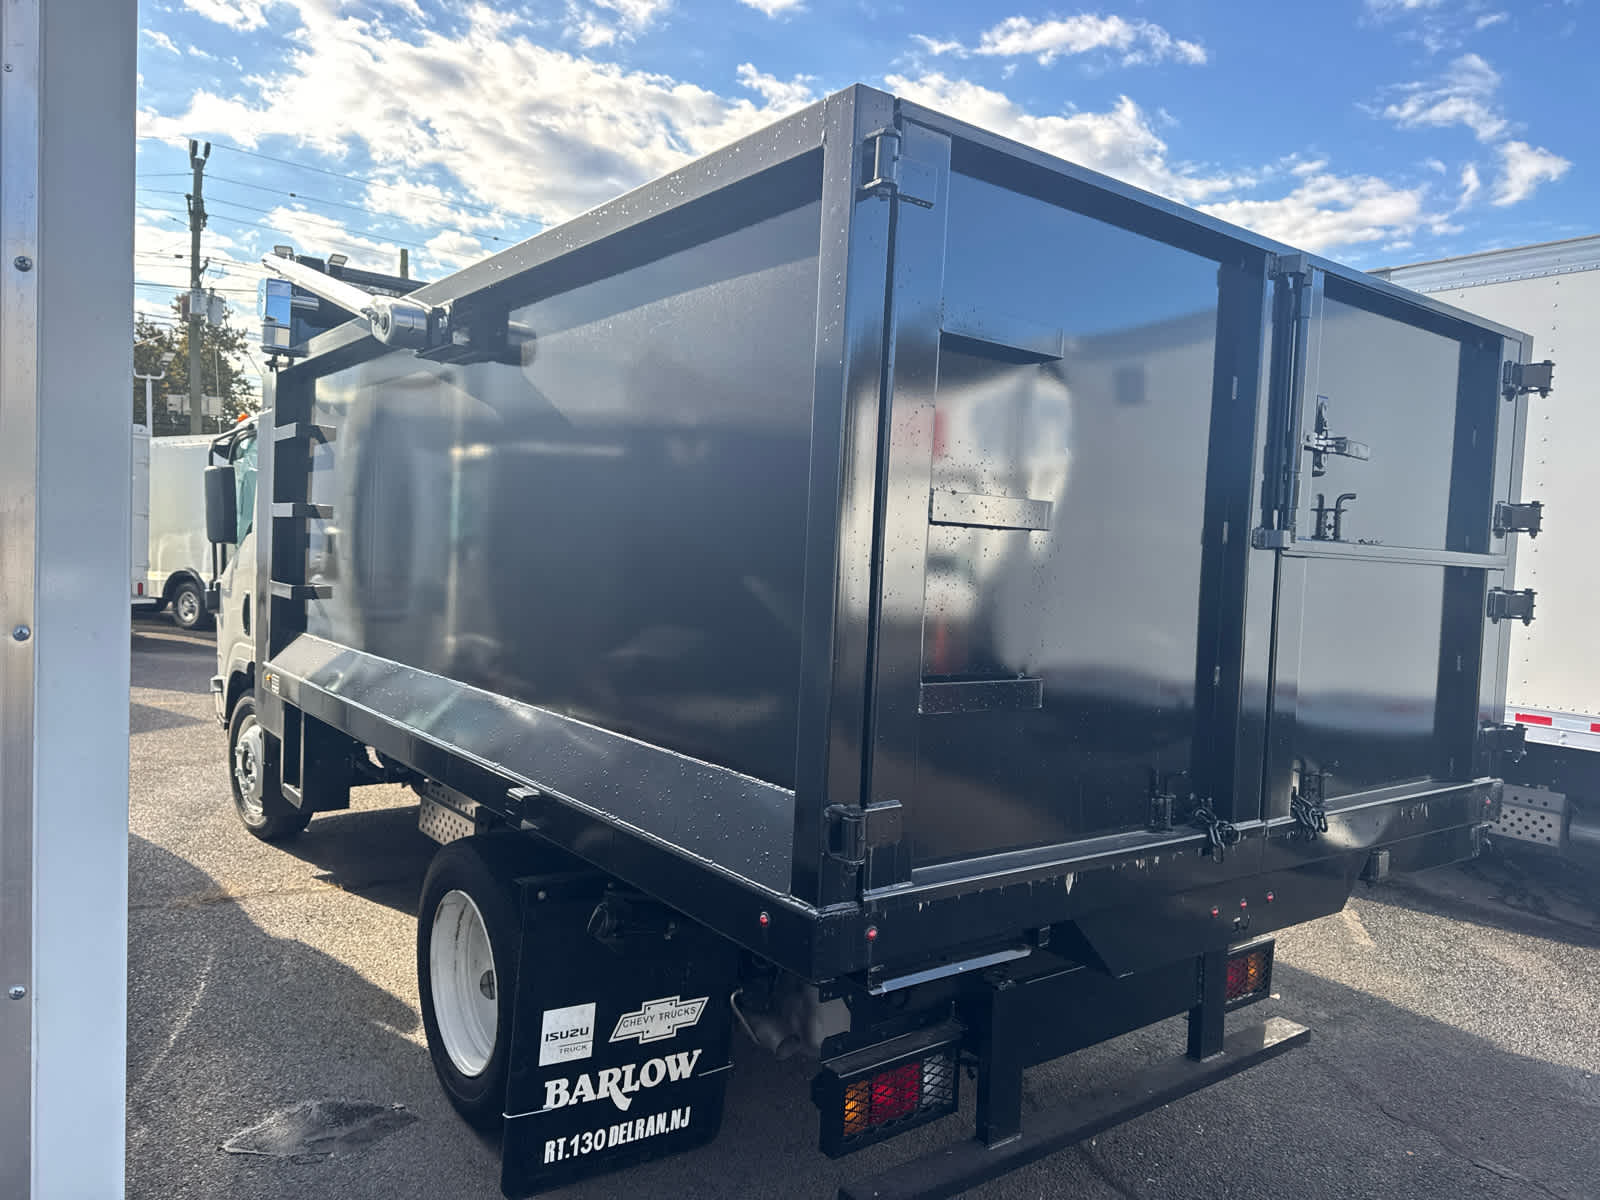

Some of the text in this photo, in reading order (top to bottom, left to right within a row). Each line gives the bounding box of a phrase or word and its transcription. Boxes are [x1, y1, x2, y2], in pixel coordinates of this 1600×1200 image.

[622, 1006, 696, 1028] CHEVY TRUCKS
[545, 1027, 589, 1042] ISUZU
[559, 1044, 588, 1054] TRUCK
[542, 1049, 702, 1111] BARLOW
